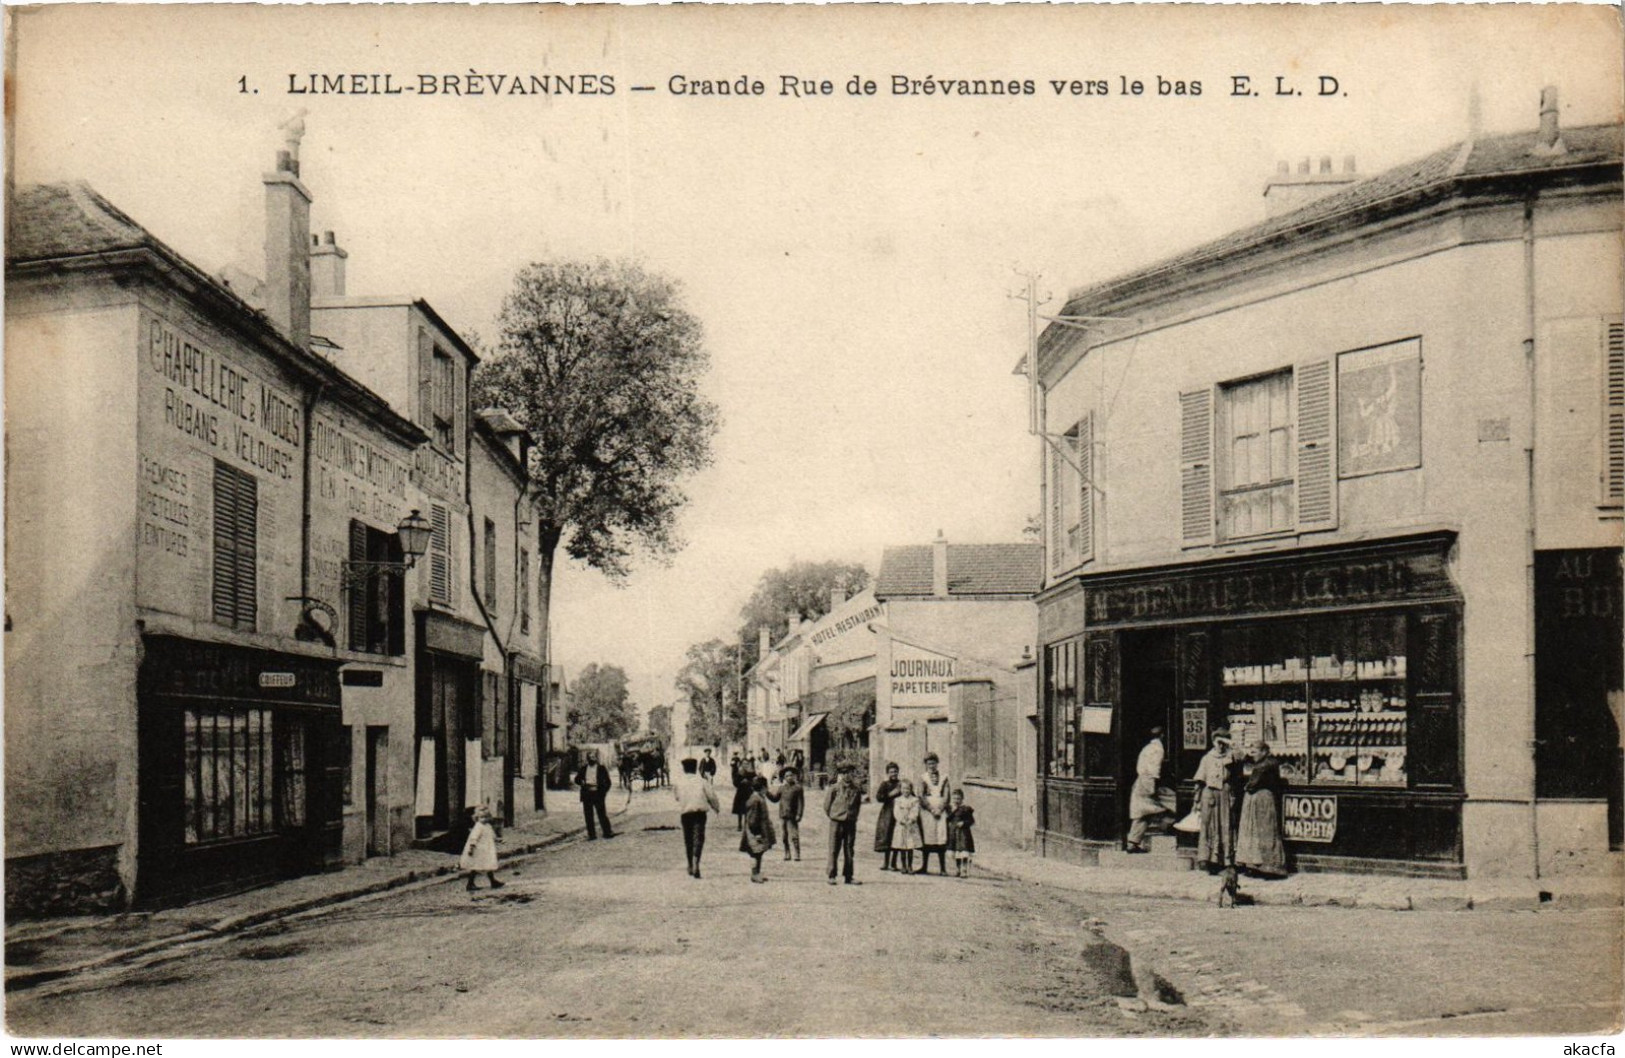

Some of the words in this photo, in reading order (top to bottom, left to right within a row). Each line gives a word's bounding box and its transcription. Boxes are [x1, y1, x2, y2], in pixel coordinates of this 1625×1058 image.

[150, 318, 249, 421] CHAPELLERIE
[260, 382, 300, 448] MODES
[165, 386, 218, 446] RUBANS
[890, 659, 954, 678] JOURNAUX
[892, 681, 948, 694] PAPETERIE
[1186, 720, 1204, 734] 35
[1285, 798, 1334, 819] MOTO
[1285, 820, 1334, 838] NAPHTA
